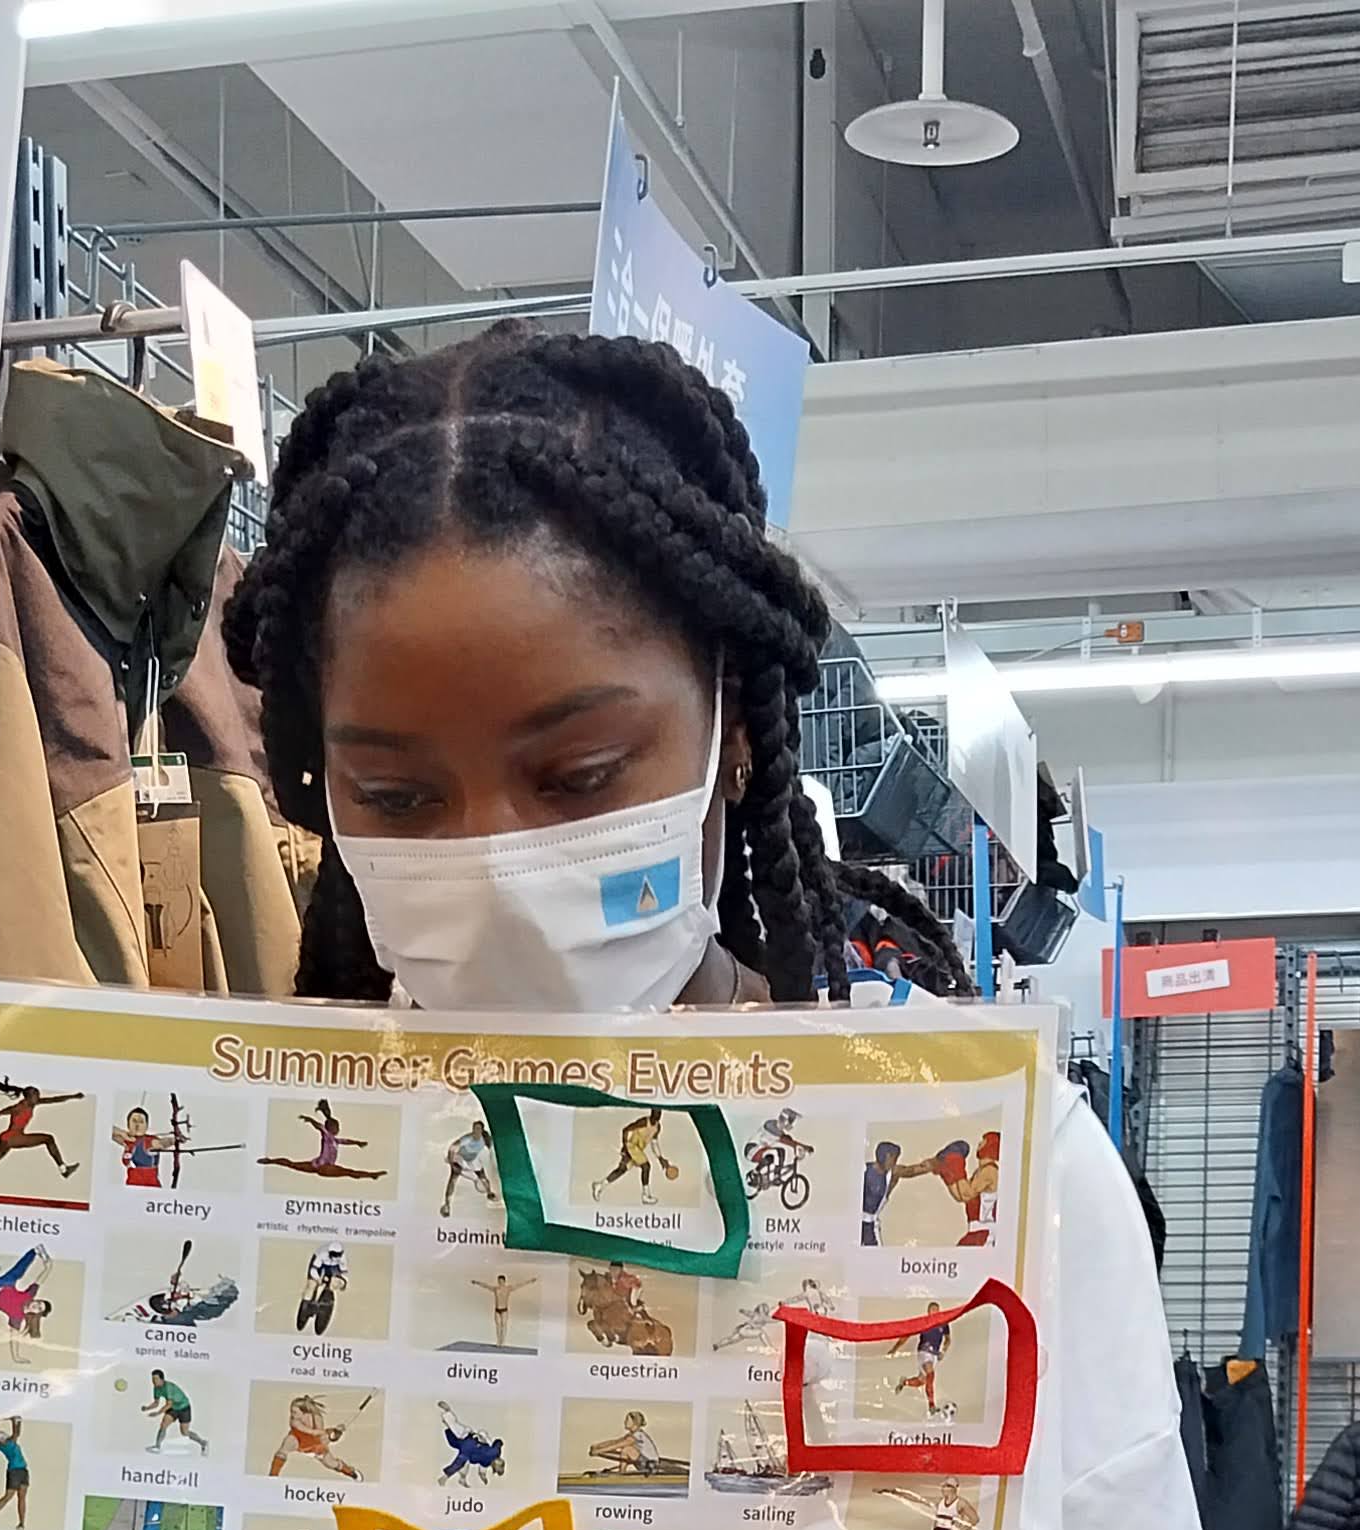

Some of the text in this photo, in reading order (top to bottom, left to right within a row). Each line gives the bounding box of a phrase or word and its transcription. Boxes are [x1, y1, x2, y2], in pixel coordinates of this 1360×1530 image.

[211, 1035, 791, 1096] Summer Games Events
[145, 1199, 211, 1220] archery
[285, 1199, 381, 1217] gymnastics
[256, 1221, 396, 1238] artistic rhythmic trampoline
[595, 1213, 681, 1230] basketball
[766, 1219, 801, 1233] BMX
[794, 1240, 825, 1253] racing
[900, 1256, 957, 1278] boxing
[144, 1327, 197, 1346] canoe
[135, 1346, 210, 1362] sprint slalom
[293, 1344, 352, 1363] cycling
[291, 1366, 350, 1379] road track
[447, 1364, 498, 1383] diving
[590, 1363, 678, 1380] equestrian
[121, 1466, 199, 1488] handball
[285, 1484, 346, 1505] hockey
[444, 1496, 484, 1514] judo
[595, 1504, 653, 1524] rowing
[742, 1505, 796, 1525] sailing
